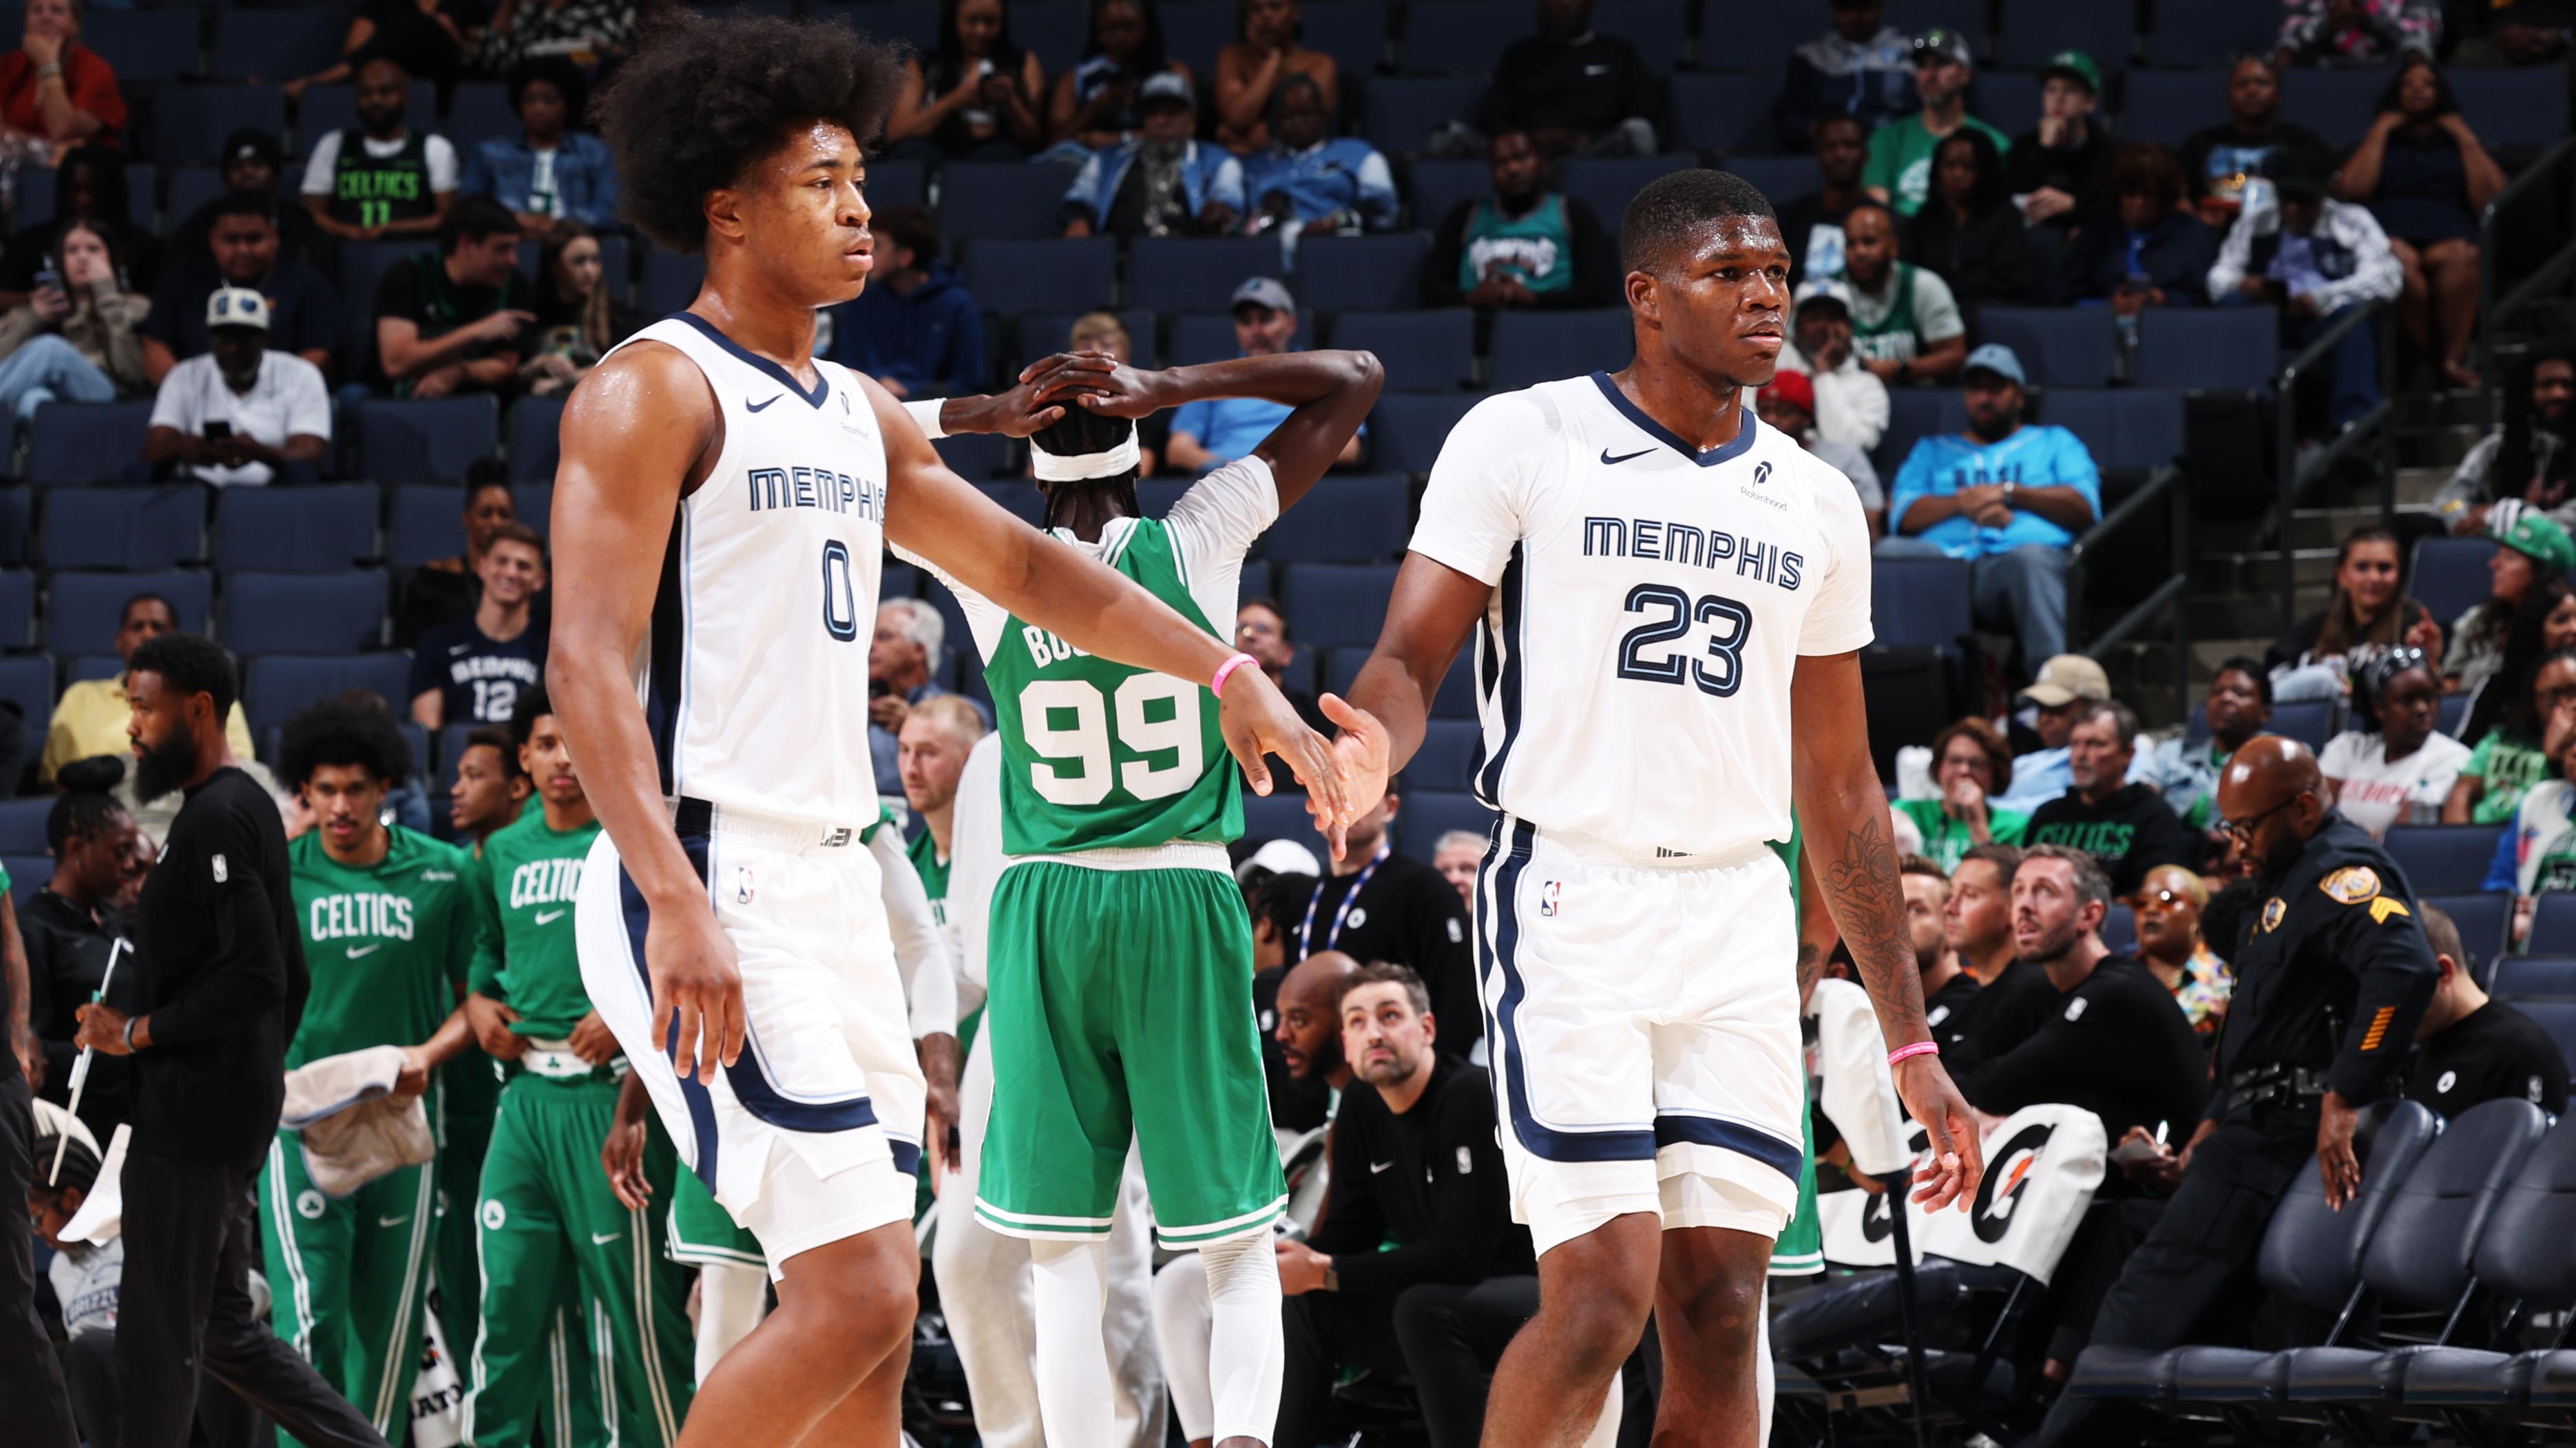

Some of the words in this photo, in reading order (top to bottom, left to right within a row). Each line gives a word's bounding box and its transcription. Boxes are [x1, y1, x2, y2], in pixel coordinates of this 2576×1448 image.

[337, 170, 419, 201] CELTICS
[359, 199, 390, 229] 11
[748, 466, 885, 526] MEMPHIS
[1739, 486, 1788, 512] Robinhood
[1584, 516, 1803, 591] MEMPHIS
[822, 538, 857, 642] 0
[1617, 583, 1753, 698] 23
[450, 655, 538, 684] MEMPHIS
[472, 679, 517, 722] 12
[1019, 671, 1204, 806] 99
[510, 857, 586, 910] CELTIC
[311, 892, 415, 942] CELTICS
[1969, 1123, 2058, 1244] G
